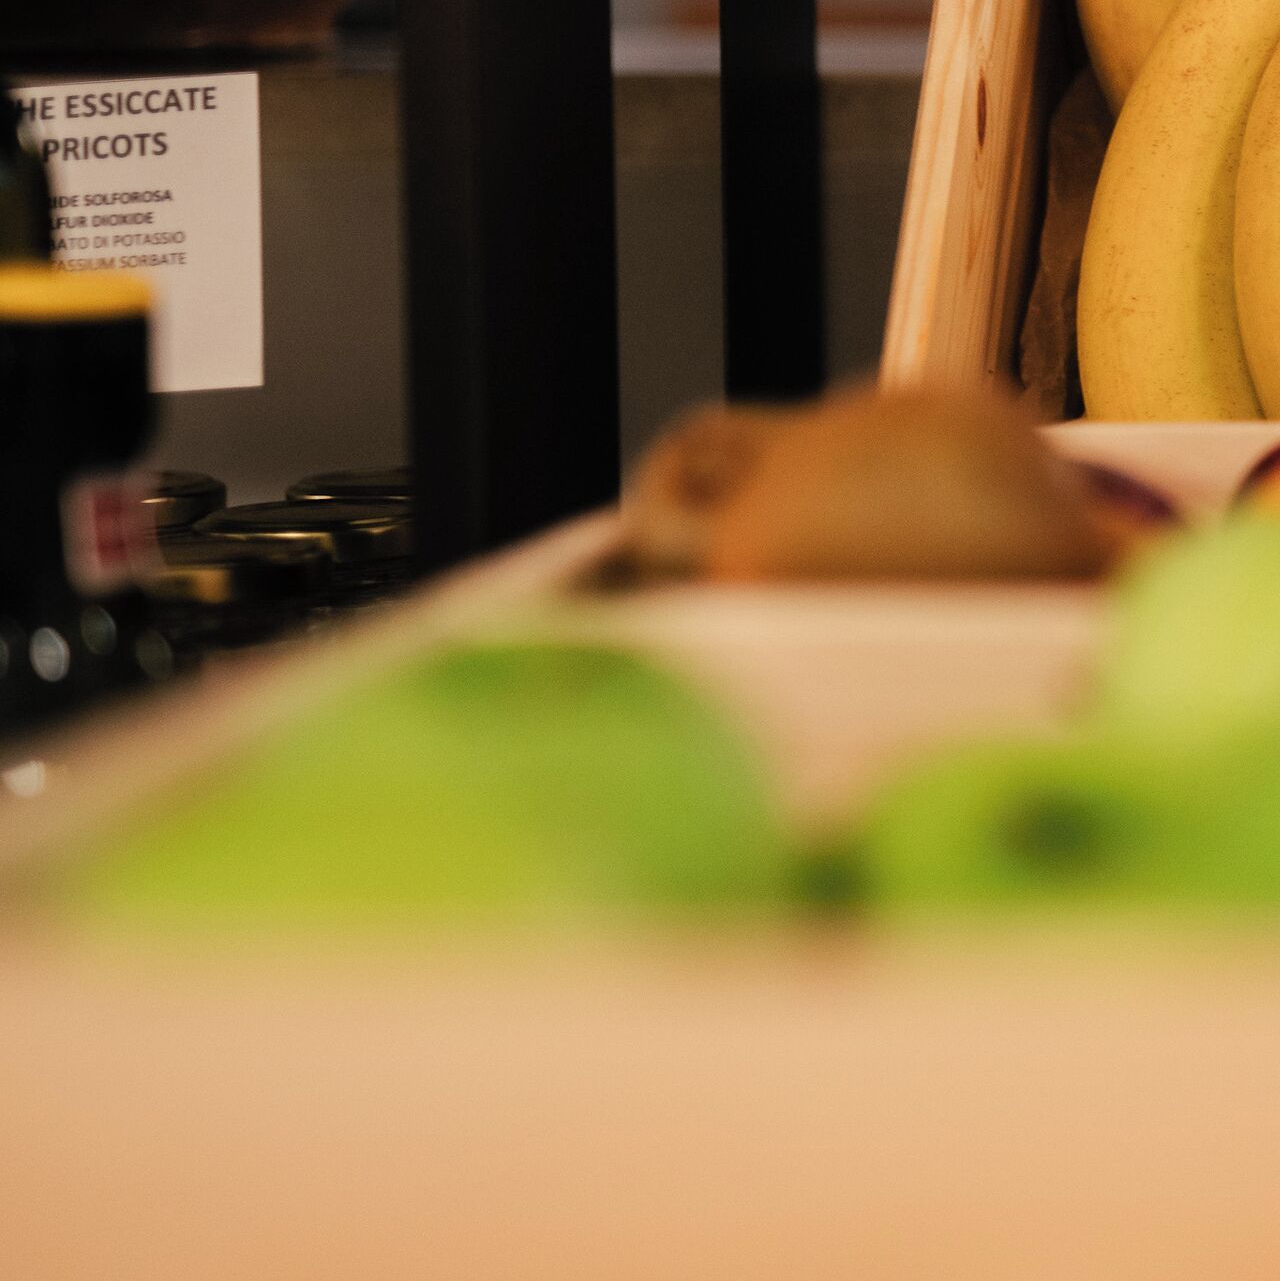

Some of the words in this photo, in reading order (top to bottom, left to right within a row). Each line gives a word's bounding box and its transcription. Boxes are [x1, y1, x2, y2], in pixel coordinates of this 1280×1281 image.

[65, 86, 218, 119] ESSICCATE
[84, 189, 173, 207] SOLFOROSA
[92, 211, 154, 228] DIOXIDE
[93, 235, 110, 250] DI
[113, 231, 186, 248] POTASSIO
[119, 252, 188, 268] SORBATE
